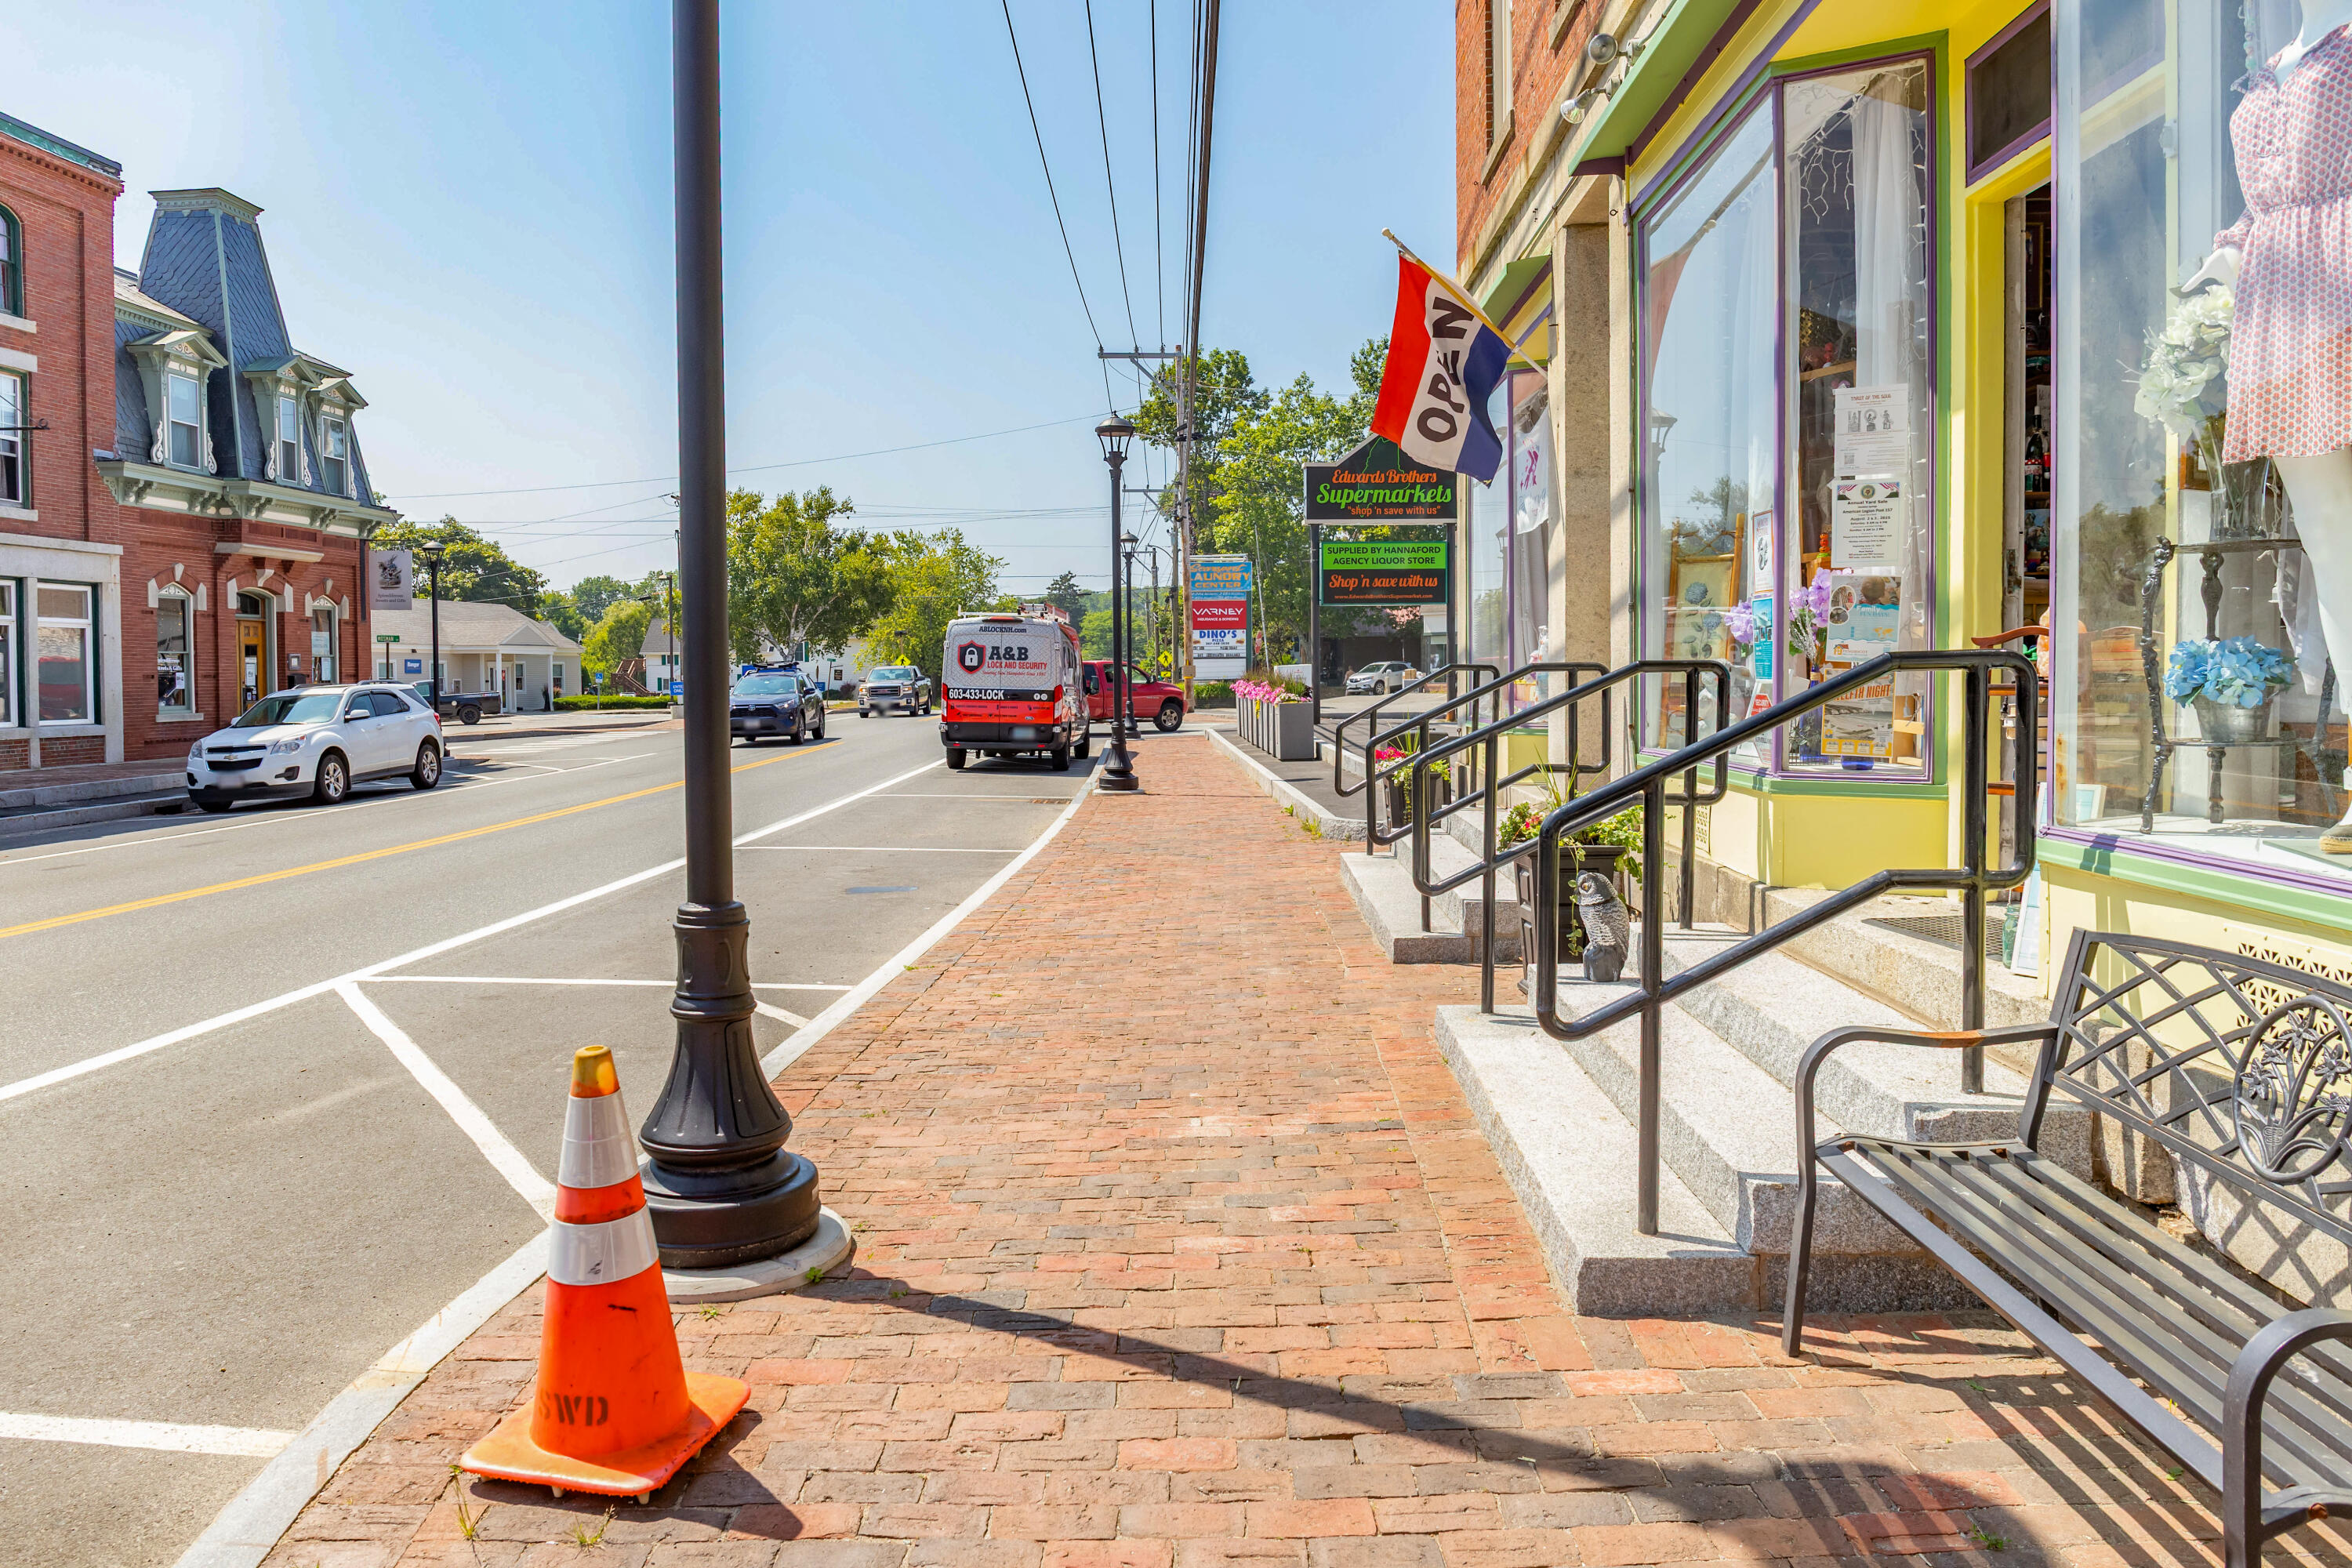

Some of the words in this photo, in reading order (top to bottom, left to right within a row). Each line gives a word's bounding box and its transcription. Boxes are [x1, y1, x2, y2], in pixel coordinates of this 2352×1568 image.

[1417, 296, 1474, 442] OPEN
[1332, 469, 1385, 483] Edwards
[1386, 469, 1437, 483] Brothers
[1316, 483, 1452, 509] Supermarkets
[1406, 506, 1425, 514] with
[1329, 574, 1359, 591] Shop
[1372, 577, 1399, 587] save
[1399, 575, 1423, 587] with
[1425, 577, 1438, 587] us
[1857, 604, 1882, 613] Family
[1199, 630, 1237, 639] DINO'S
[989, 646, 1029, 660] A&B
[1018, 662, 1047, 670] SECURITY
[949, 688, 1004, 700] 603-433-LOCK
[1867, 684, 1890, 698] NIGHT
[539, 1388, 608, 1426] SWD
